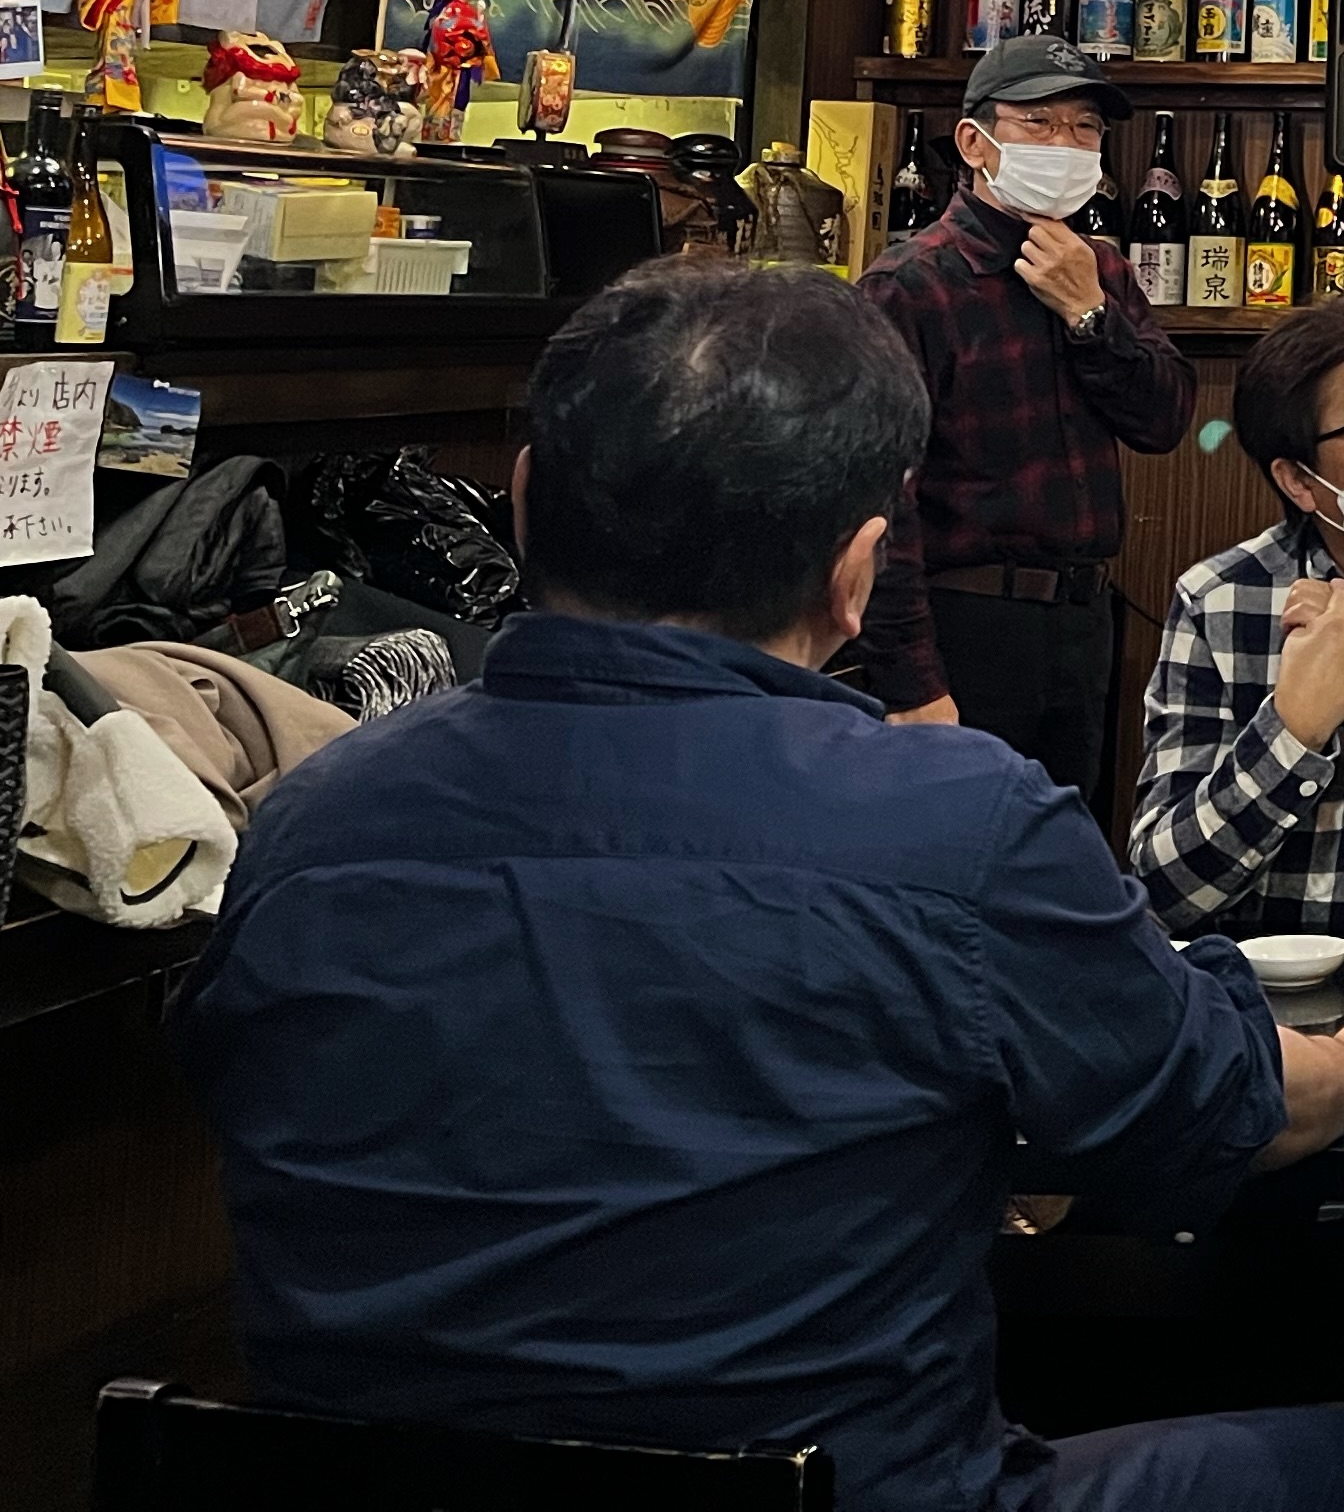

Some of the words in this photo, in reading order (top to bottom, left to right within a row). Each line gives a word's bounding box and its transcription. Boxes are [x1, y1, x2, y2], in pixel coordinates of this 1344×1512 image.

[1201, 245, 1231, 301] 瑞泉
[52, 365, 97, 410] 店内
[0, 416, 62, 462] 禁煙
